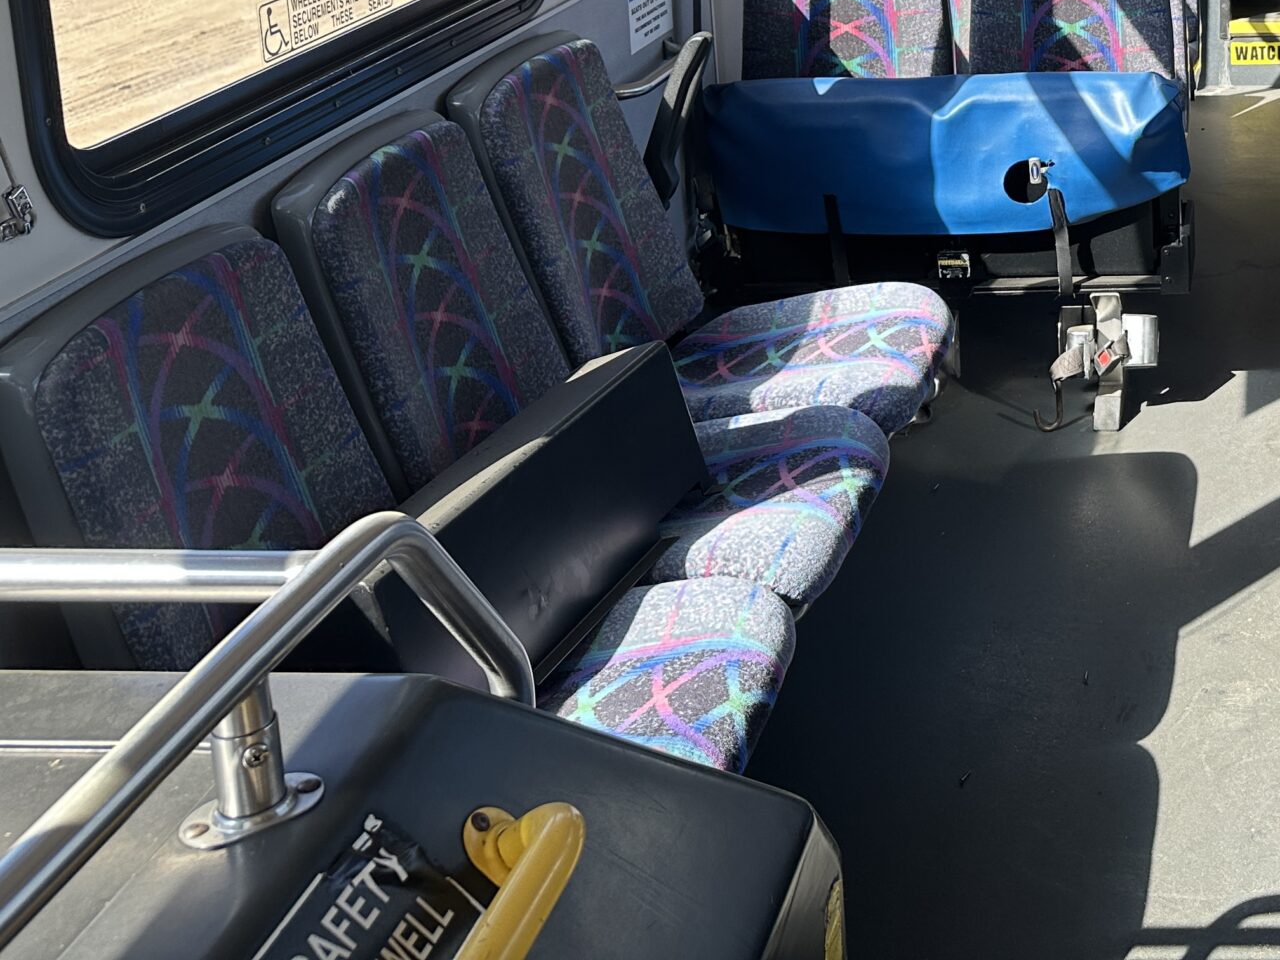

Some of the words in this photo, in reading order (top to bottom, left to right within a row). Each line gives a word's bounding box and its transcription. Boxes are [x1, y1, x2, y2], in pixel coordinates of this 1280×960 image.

[294, 22, 320, 45] BELOW
[331, 7, 354, 27] THESE
[291, 847, 409, 960] AFETY
